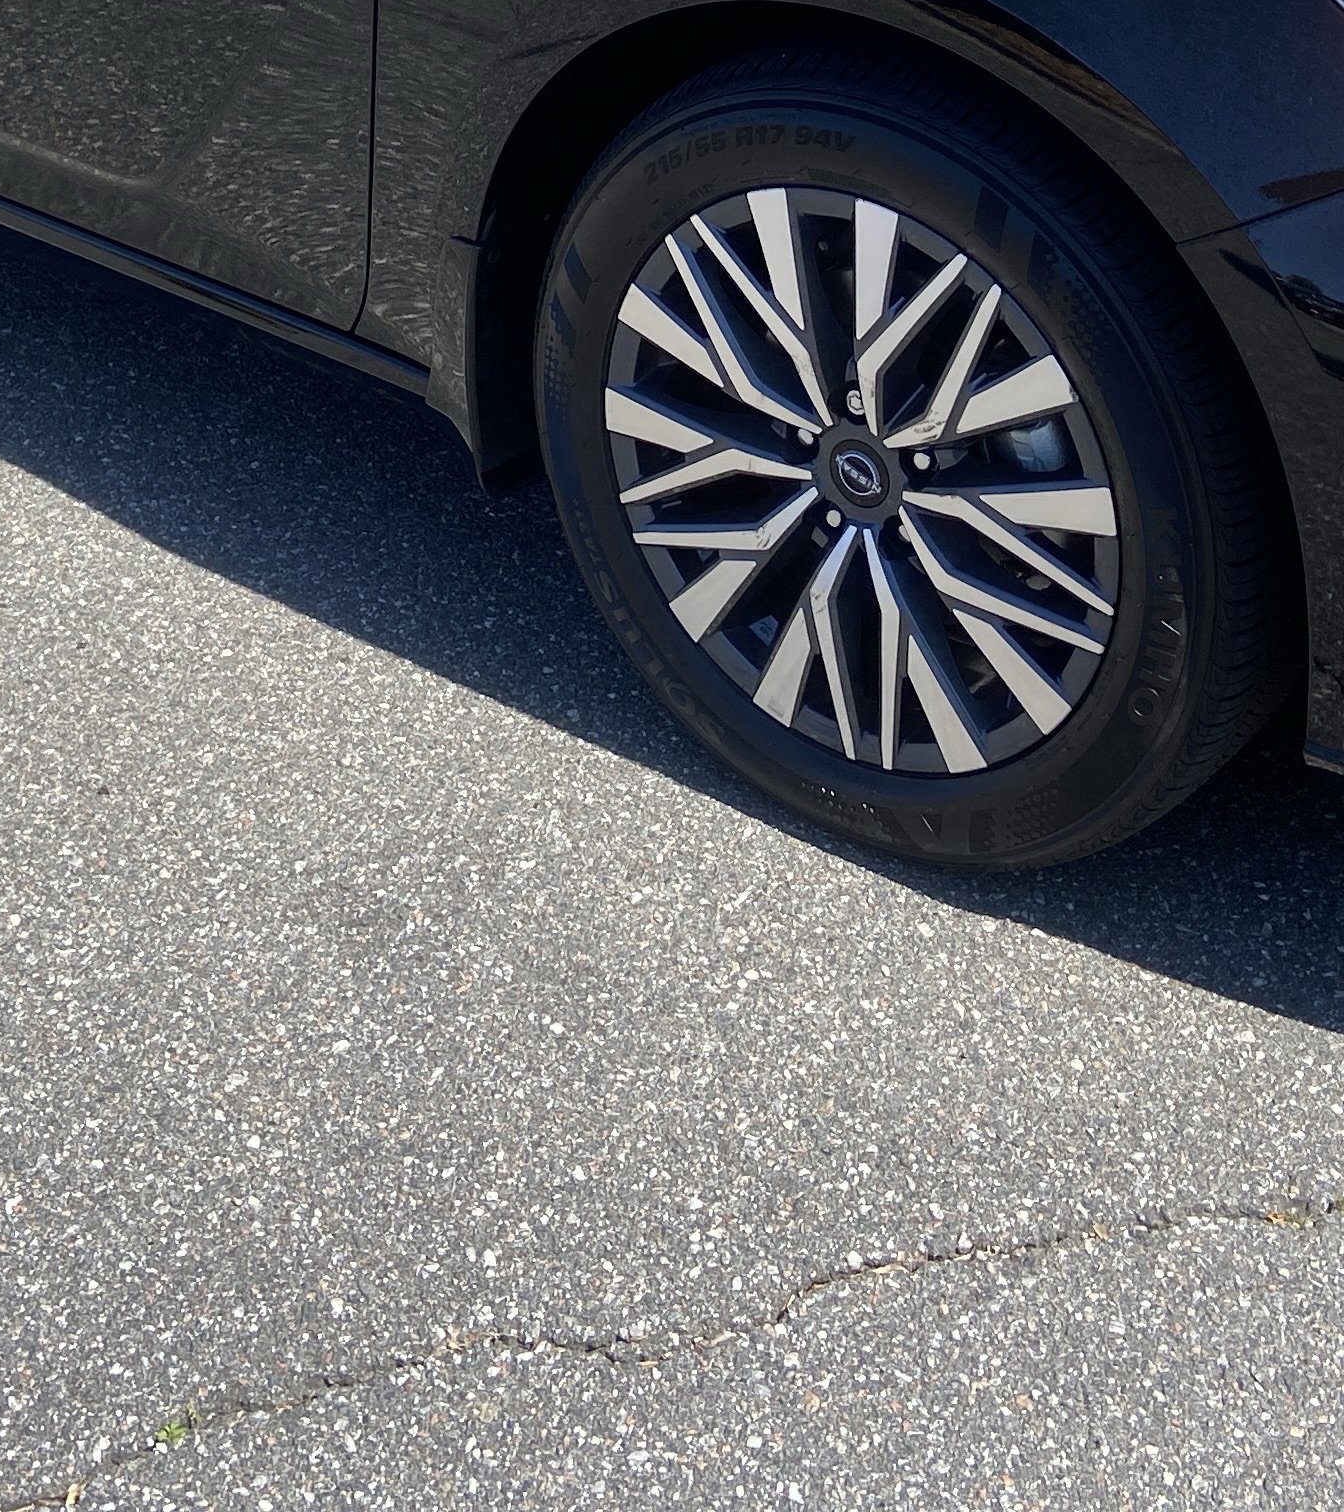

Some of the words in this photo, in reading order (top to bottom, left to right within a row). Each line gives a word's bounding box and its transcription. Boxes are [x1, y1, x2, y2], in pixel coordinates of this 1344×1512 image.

[643, 129, 728, 185] 215/55
[735, 124, 786, 149] R17
[793, 125, 858, 153] 94V
[835, 454, 882, 494] NISSAN
[1127, 507, 1186, 726] KUMHO
